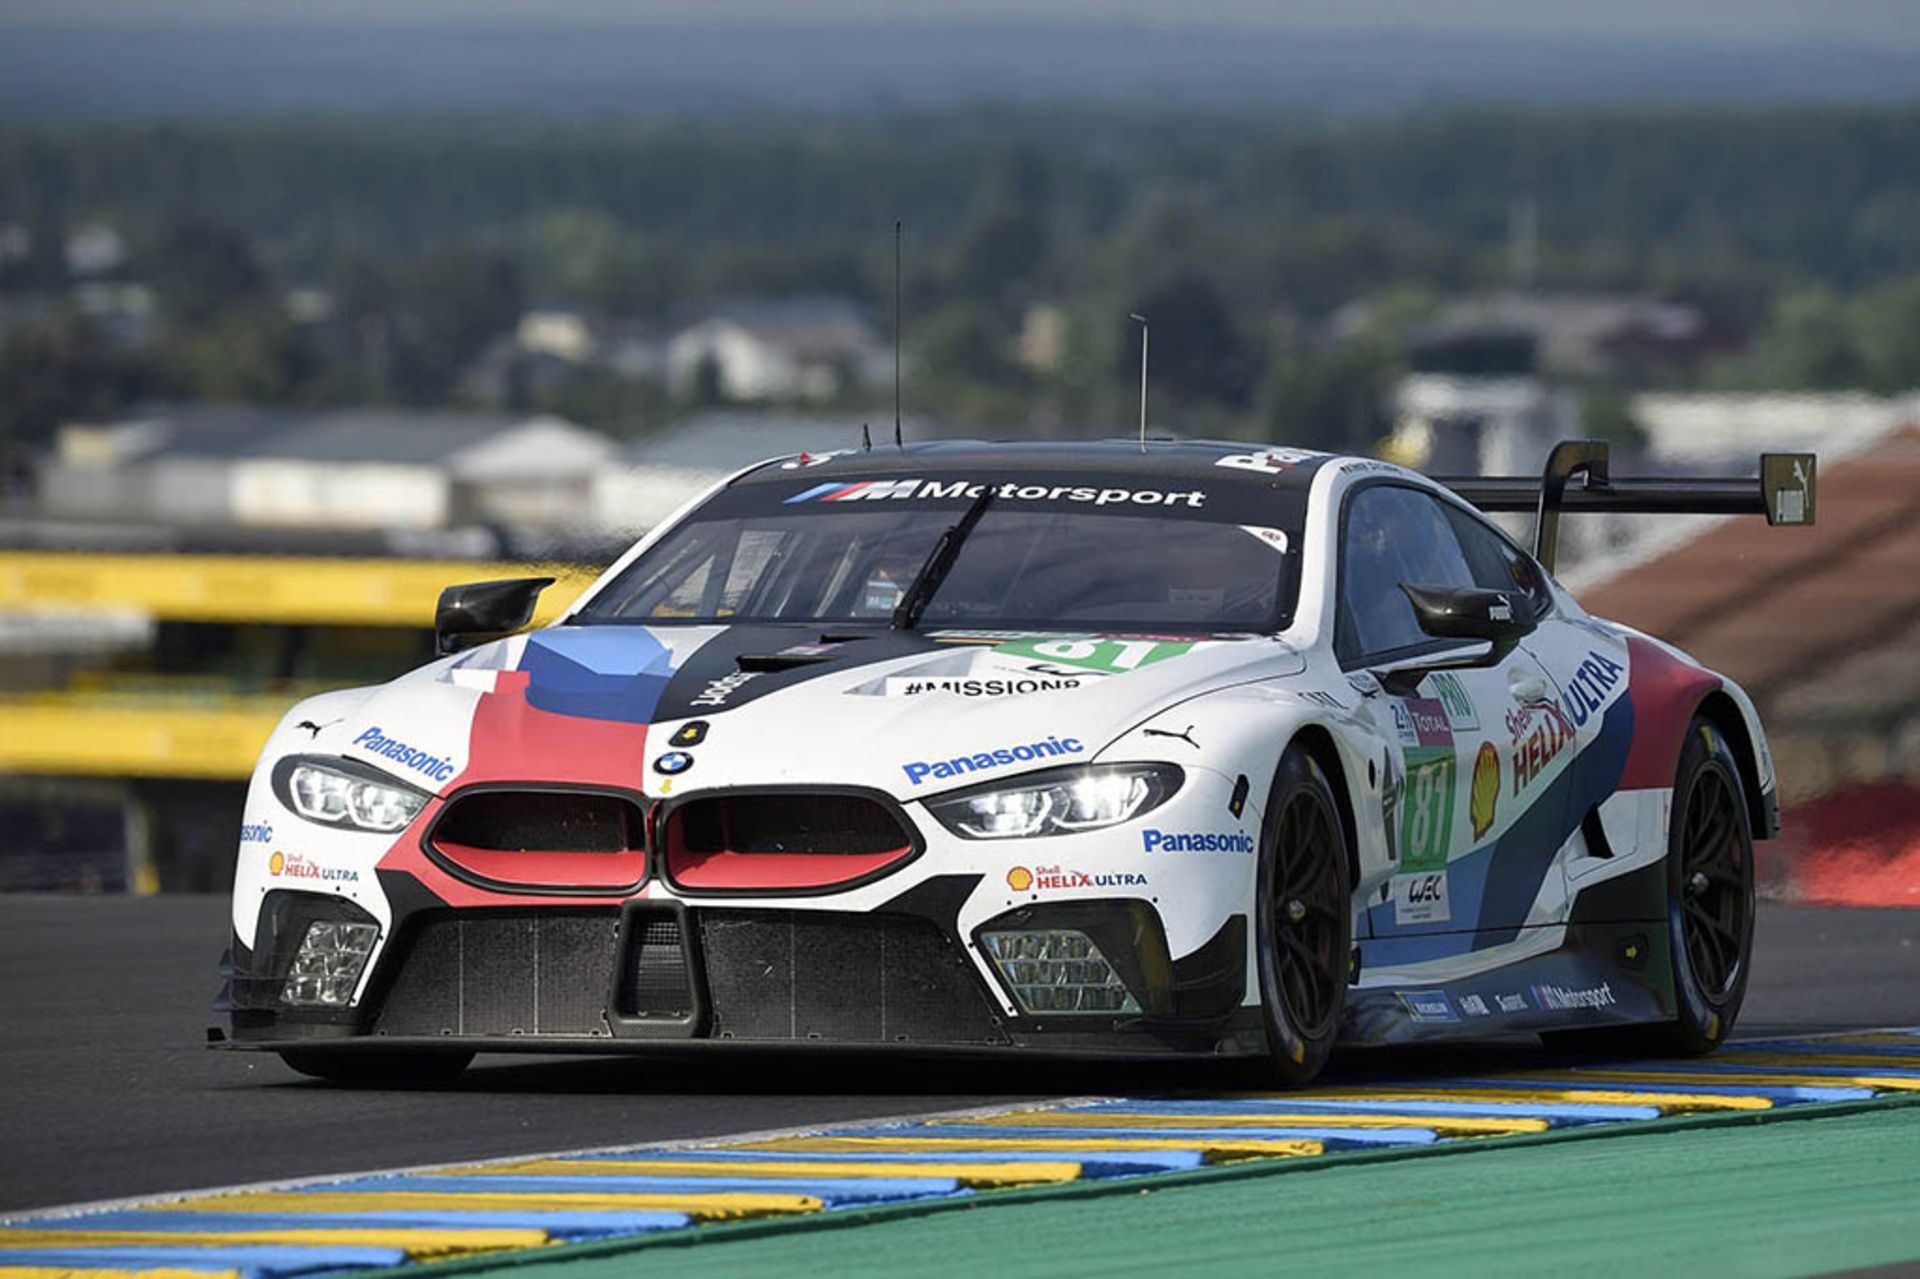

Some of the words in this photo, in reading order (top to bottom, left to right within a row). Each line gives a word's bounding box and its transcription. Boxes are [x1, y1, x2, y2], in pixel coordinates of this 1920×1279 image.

[917, 480, 1207, 508] Motorsport
[1411, 712, 1449, 732] TOTAL
[1513, 699, 1576, 798] HELIX
[1562, 651, 1624, 727] ULTRA
[352, 726, 455, 782] Panasonic
[902, 735, 1085, 786] Panasonic
[1411, 764, 1447, 856] 81
[1142, 829, 1254, 853] Panasonic
[284, 859, 321, 880] HELIX
[322, 868, 359, 882] ULTRA
[1035, 866, 1061, 876] Shell
[1036, 870, 1093, 889] HELIX
[1095, 873, 1147, 887] ULTRA
